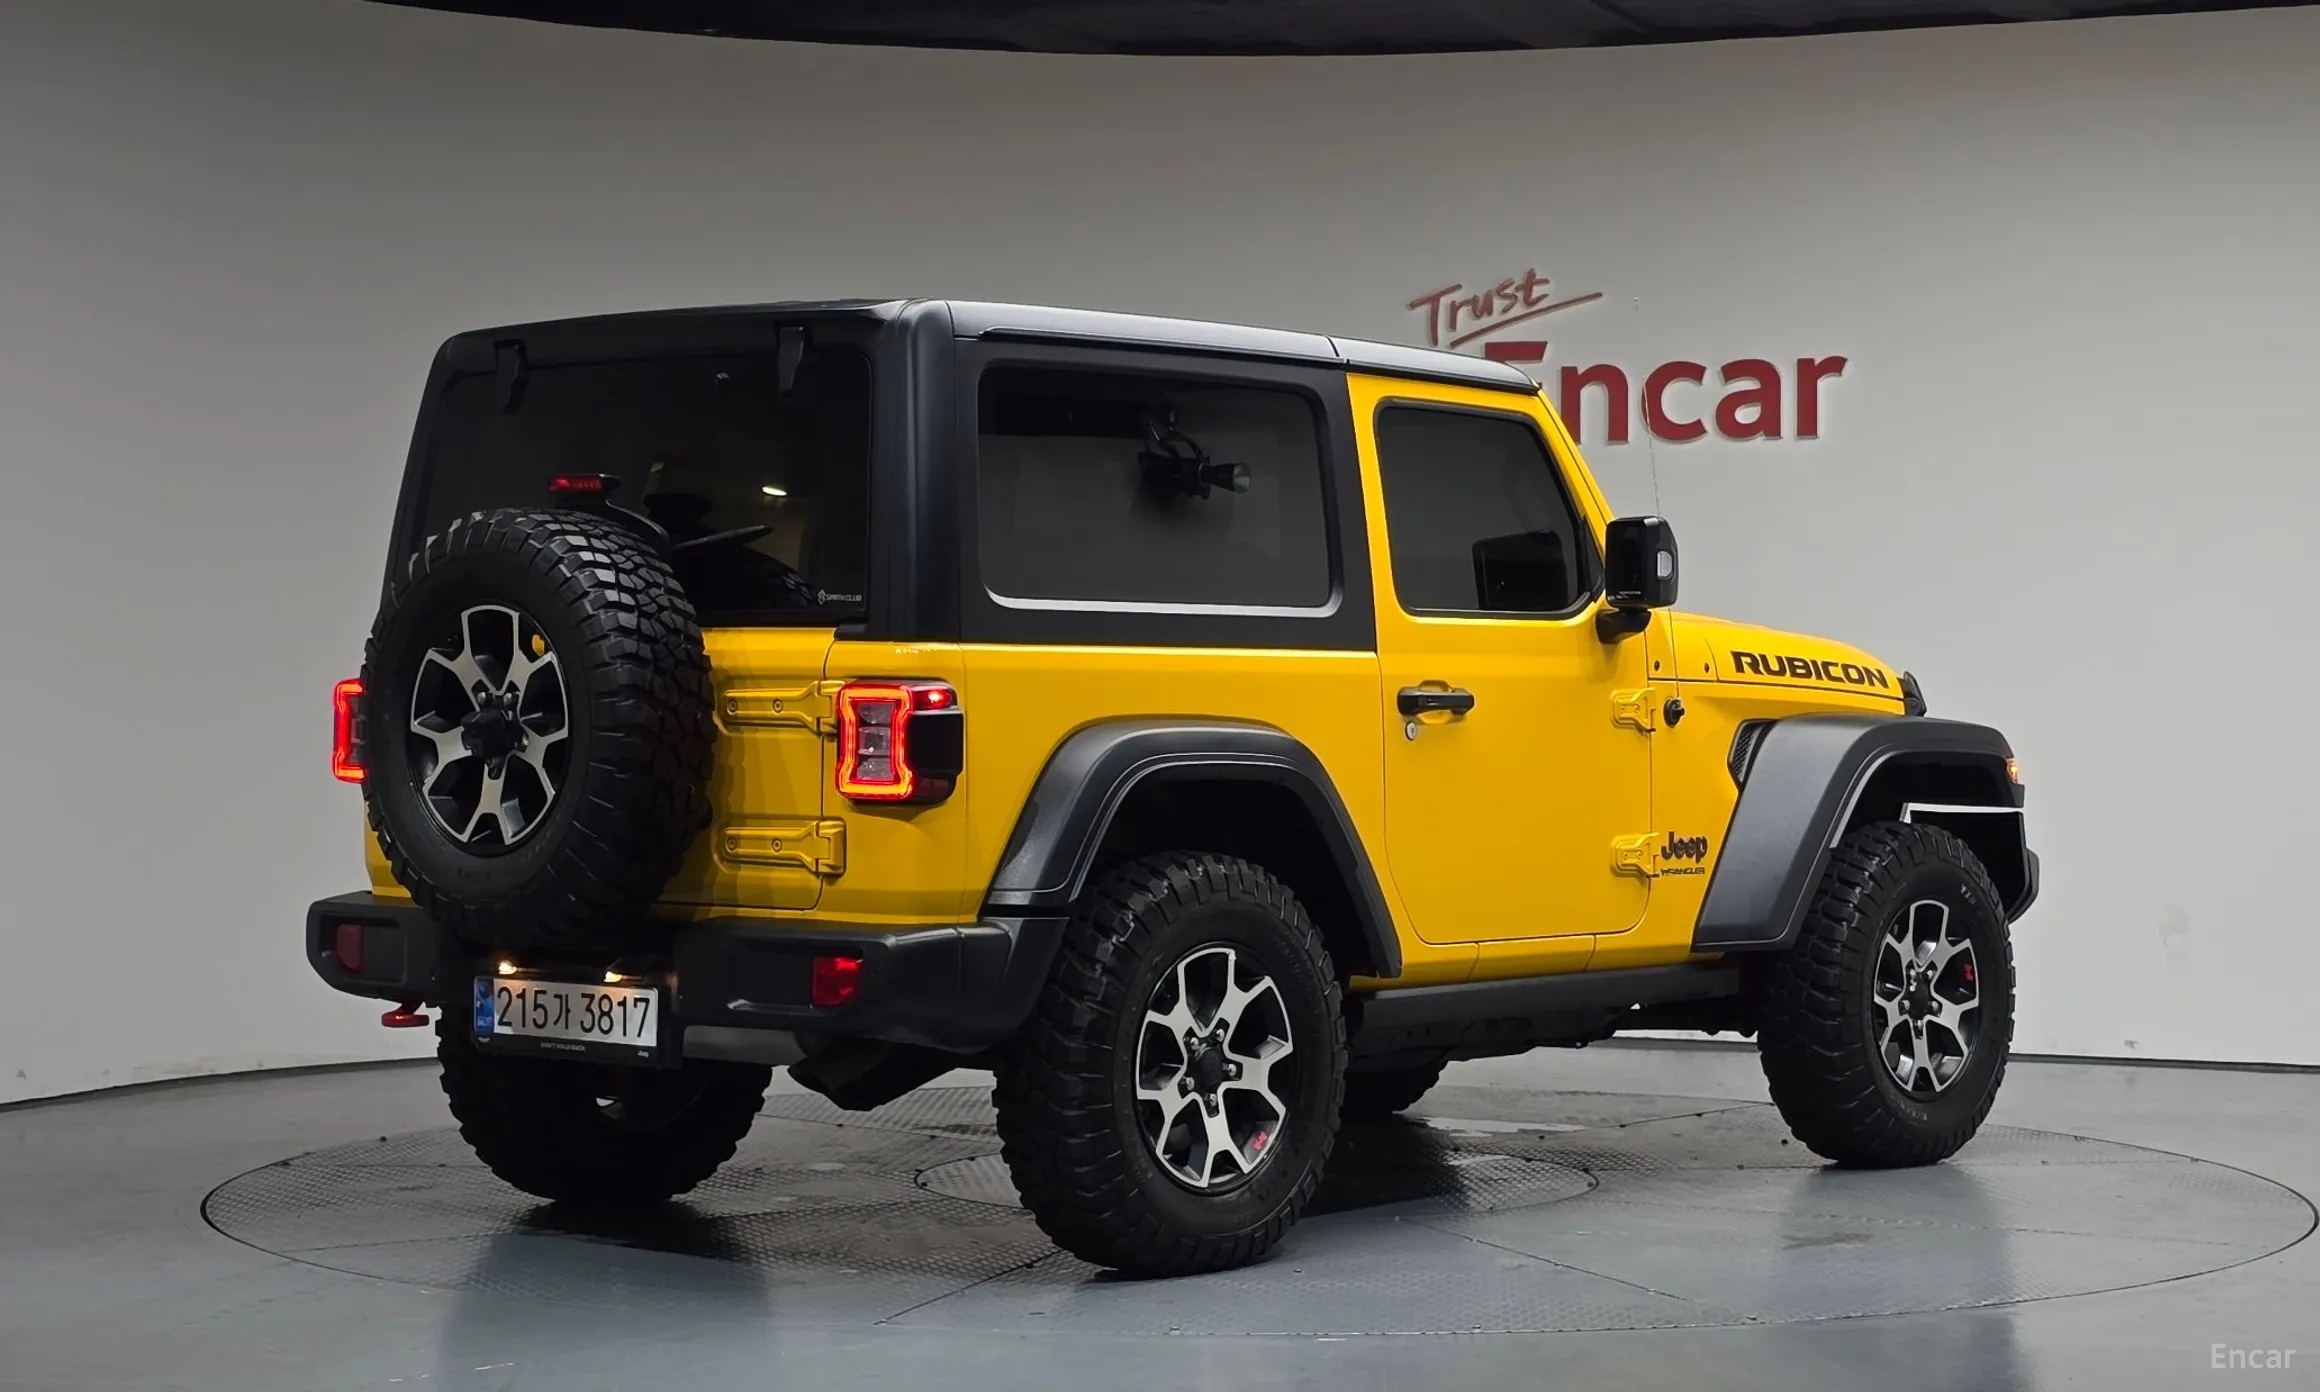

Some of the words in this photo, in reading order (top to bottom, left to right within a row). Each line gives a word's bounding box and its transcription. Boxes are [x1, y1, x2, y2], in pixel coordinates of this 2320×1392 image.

[1408, 268, 1550, 346] Trust
[1485, 341, 1848, 444] ncar
[1730, 650, 1890, 689] RUBICON
[1660, 831, 1708, 863] Jeep
[497, 986, 571, 1030] 215가
[580, 993, 651, 1038] 3817
